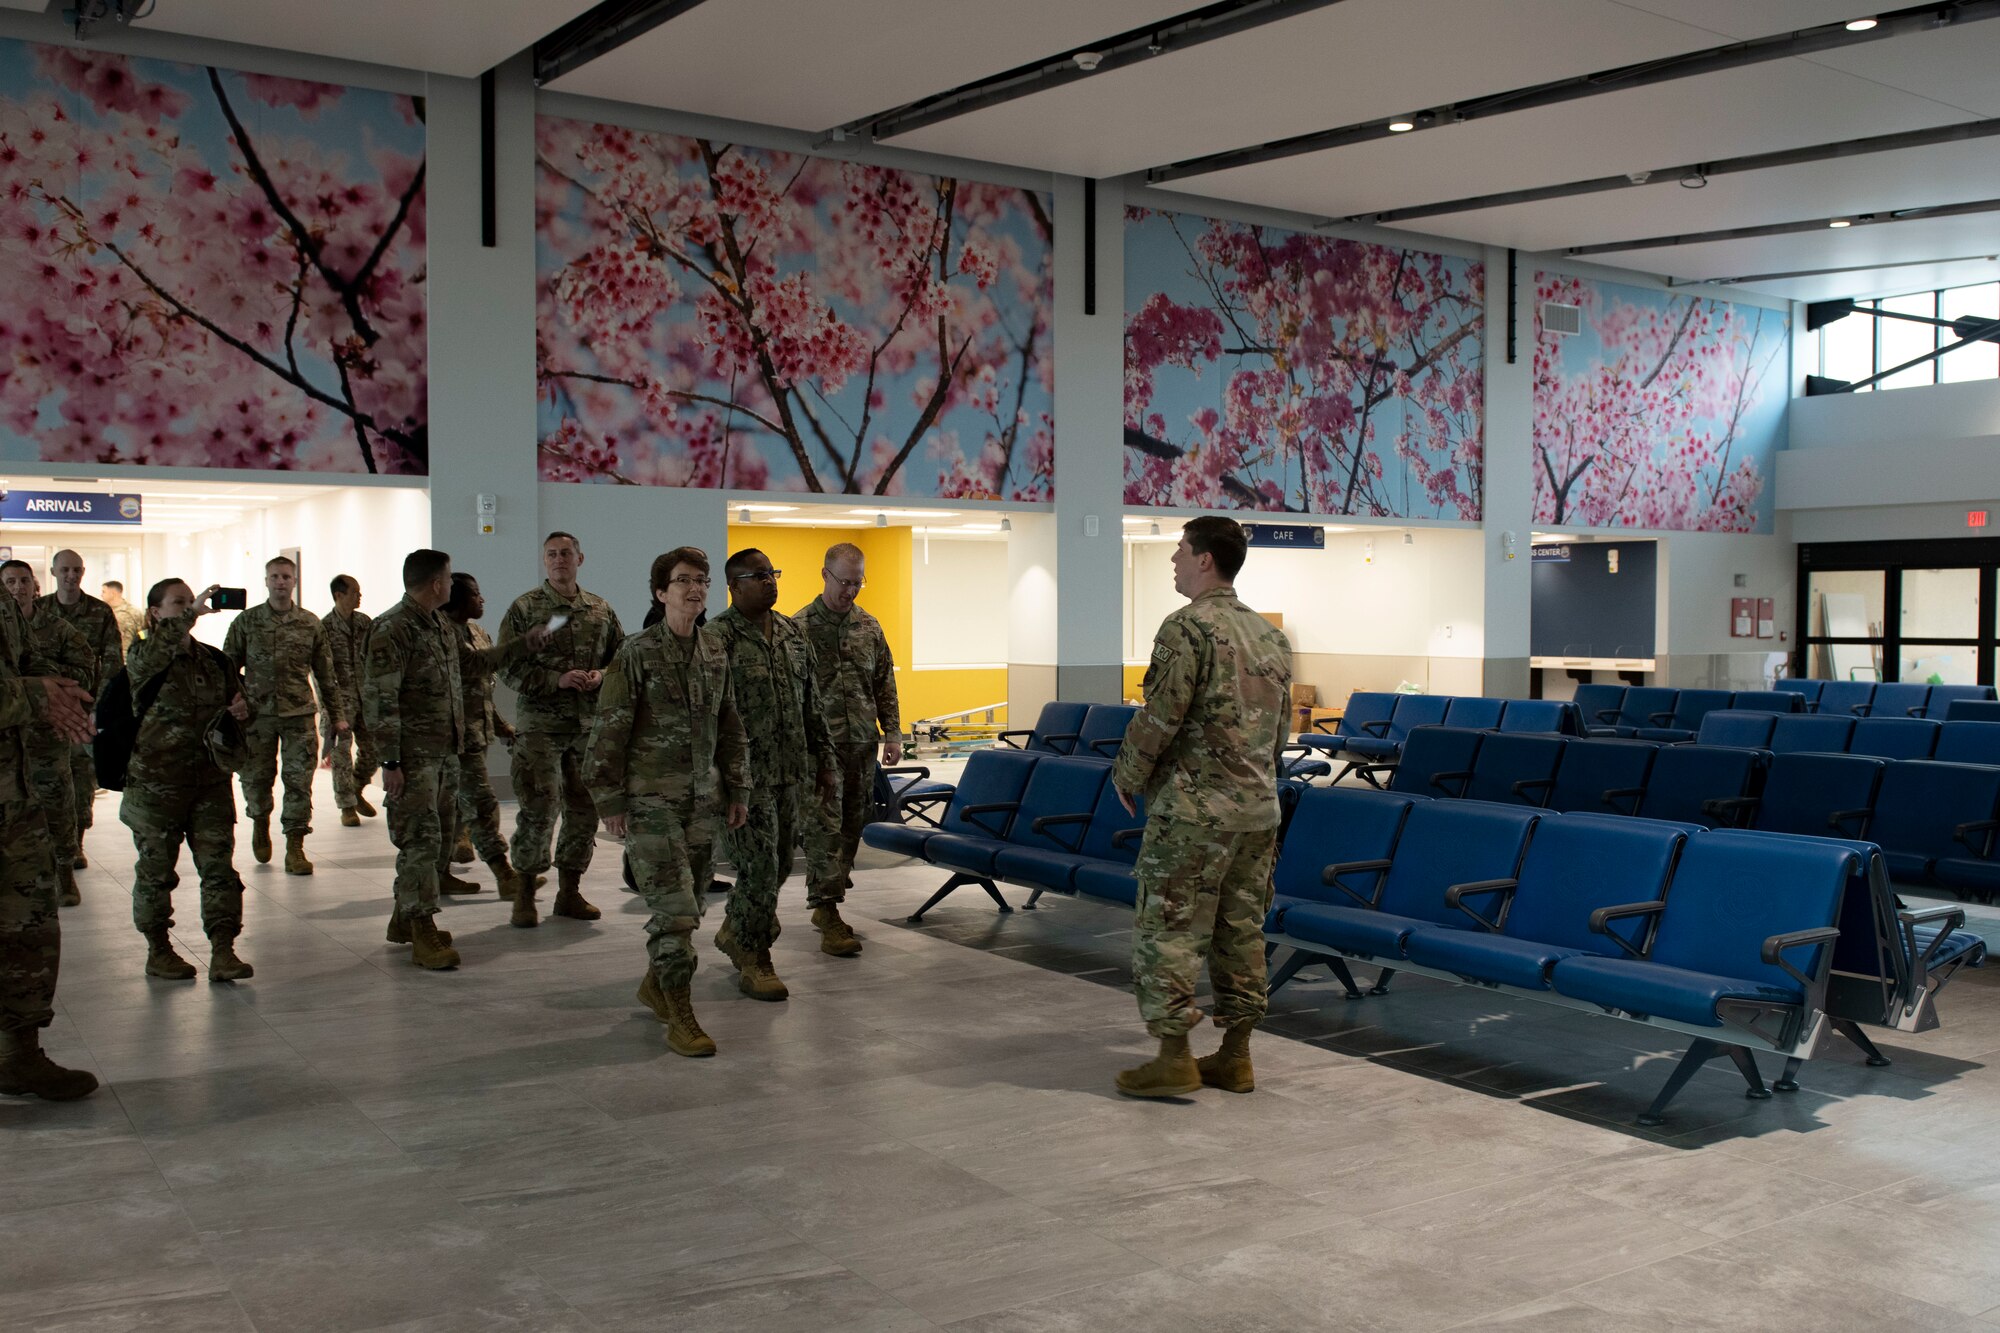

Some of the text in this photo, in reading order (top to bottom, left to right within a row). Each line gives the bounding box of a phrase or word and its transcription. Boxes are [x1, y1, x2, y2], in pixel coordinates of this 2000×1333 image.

[26, 498, 92, 513] ARRIVALS
[1969, 511, 1986, 526] EXIT
[1273, 530, 1294, 540] CAFE
[1538, 548, 1561, 557] CENTER
